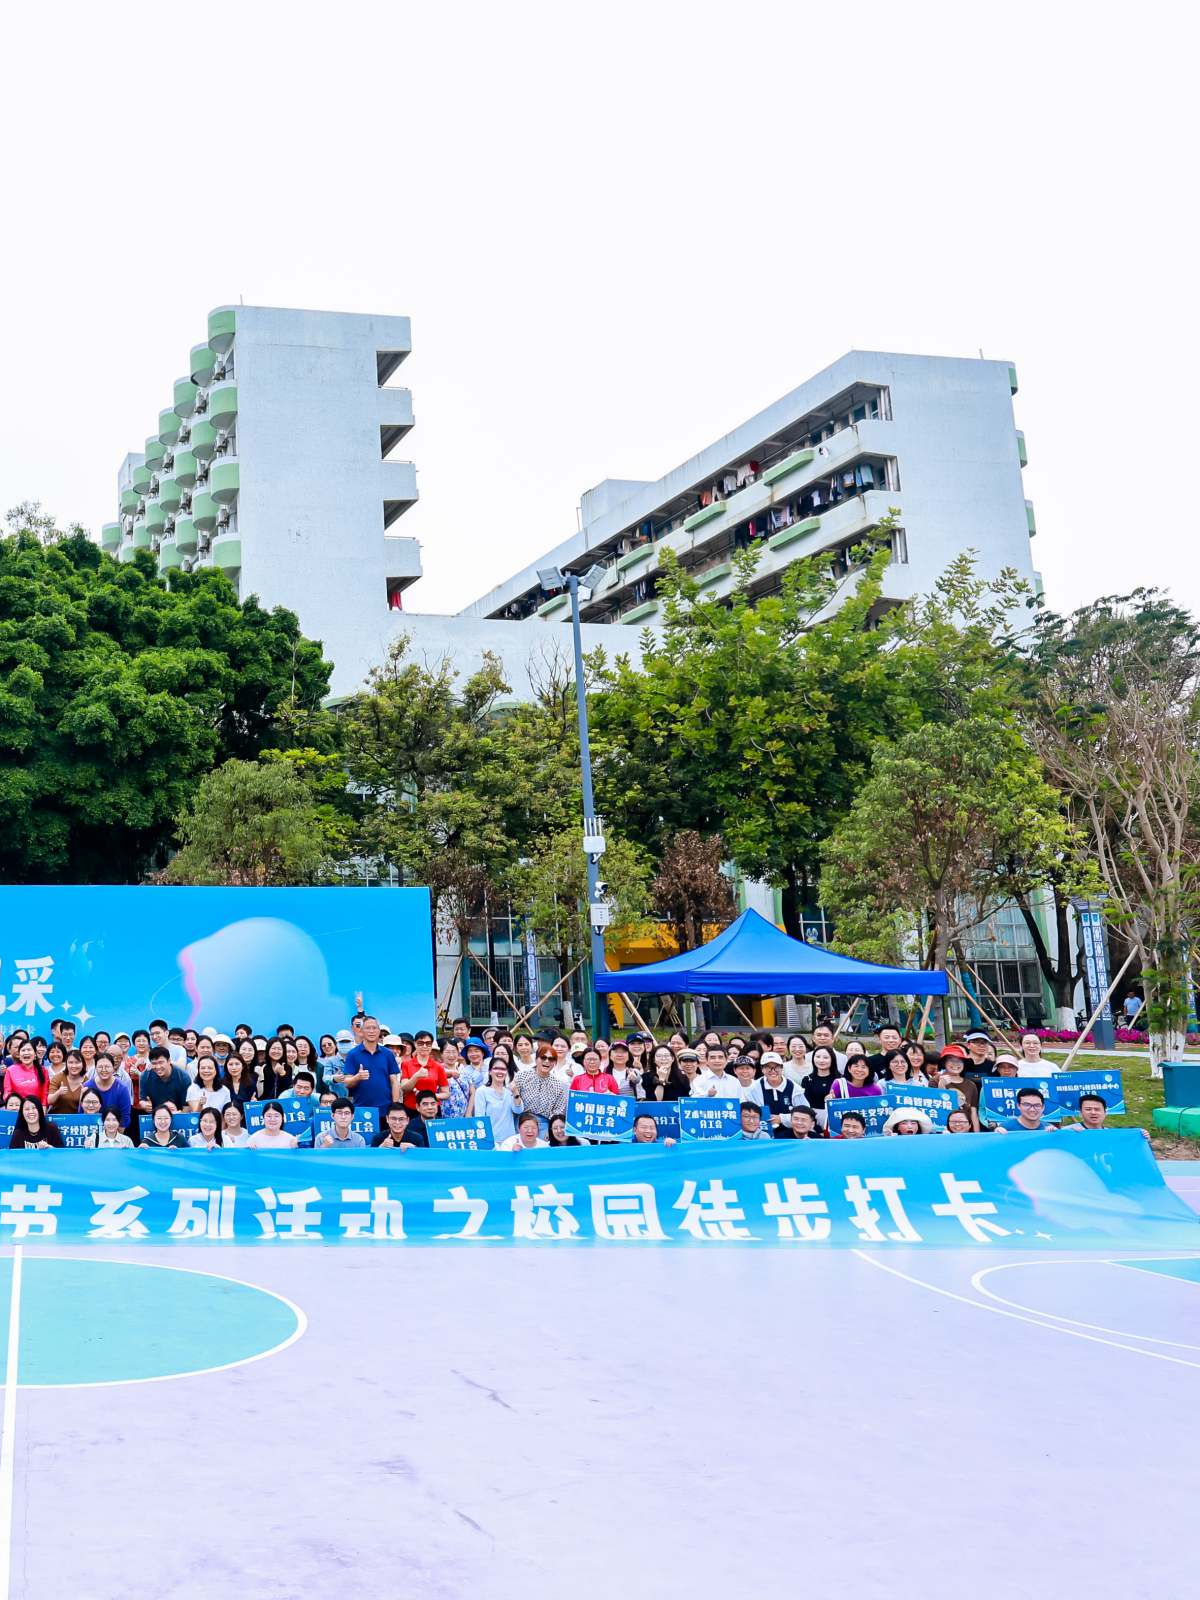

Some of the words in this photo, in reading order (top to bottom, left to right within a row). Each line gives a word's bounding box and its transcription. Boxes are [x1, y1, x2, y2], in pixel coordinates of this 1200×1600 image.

[896, 1095, 953, 1111] 工商管理学院
[574, 1102, 628, 1118] 外国语学院
[684, 1110, 737, 1120] 艺术与设计学院
[585, 1115, 615, 1128] 分工会
[699, 1119, 723, 1129] 分工会
